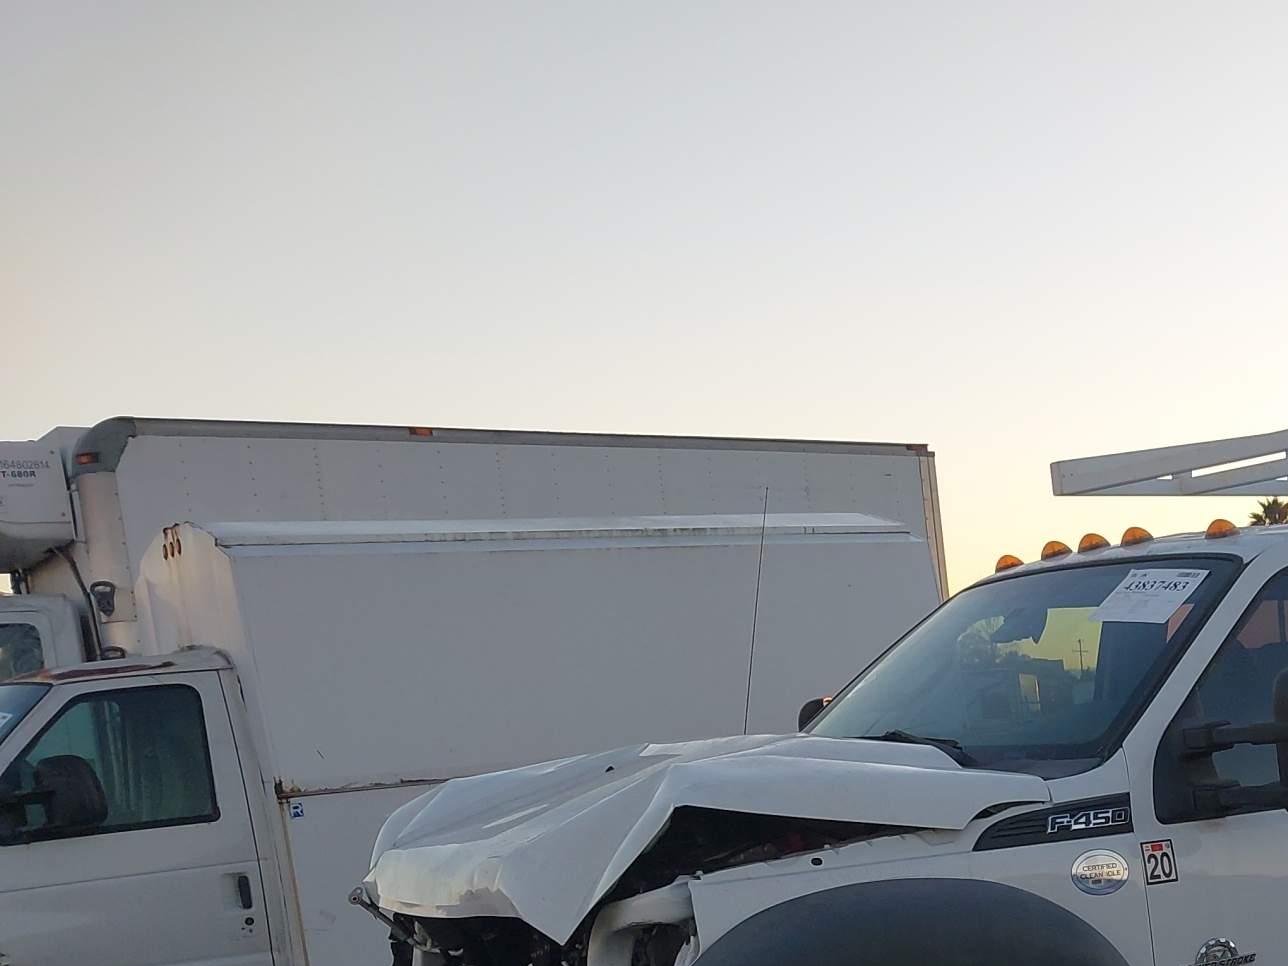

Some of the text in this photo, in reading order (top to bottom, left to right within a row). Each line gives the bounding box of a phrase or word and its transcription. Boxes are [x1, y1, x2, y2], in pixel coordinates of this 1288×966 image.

[1124, 580, 1190, 592] 43837483
[1047, 807, 1130, 834] F-450
[1082, 862, 1117, 872] CERTIFIED
[1146, 851, 1173, 880] 20
[1080, 871, 1104, 880] CLEAN
